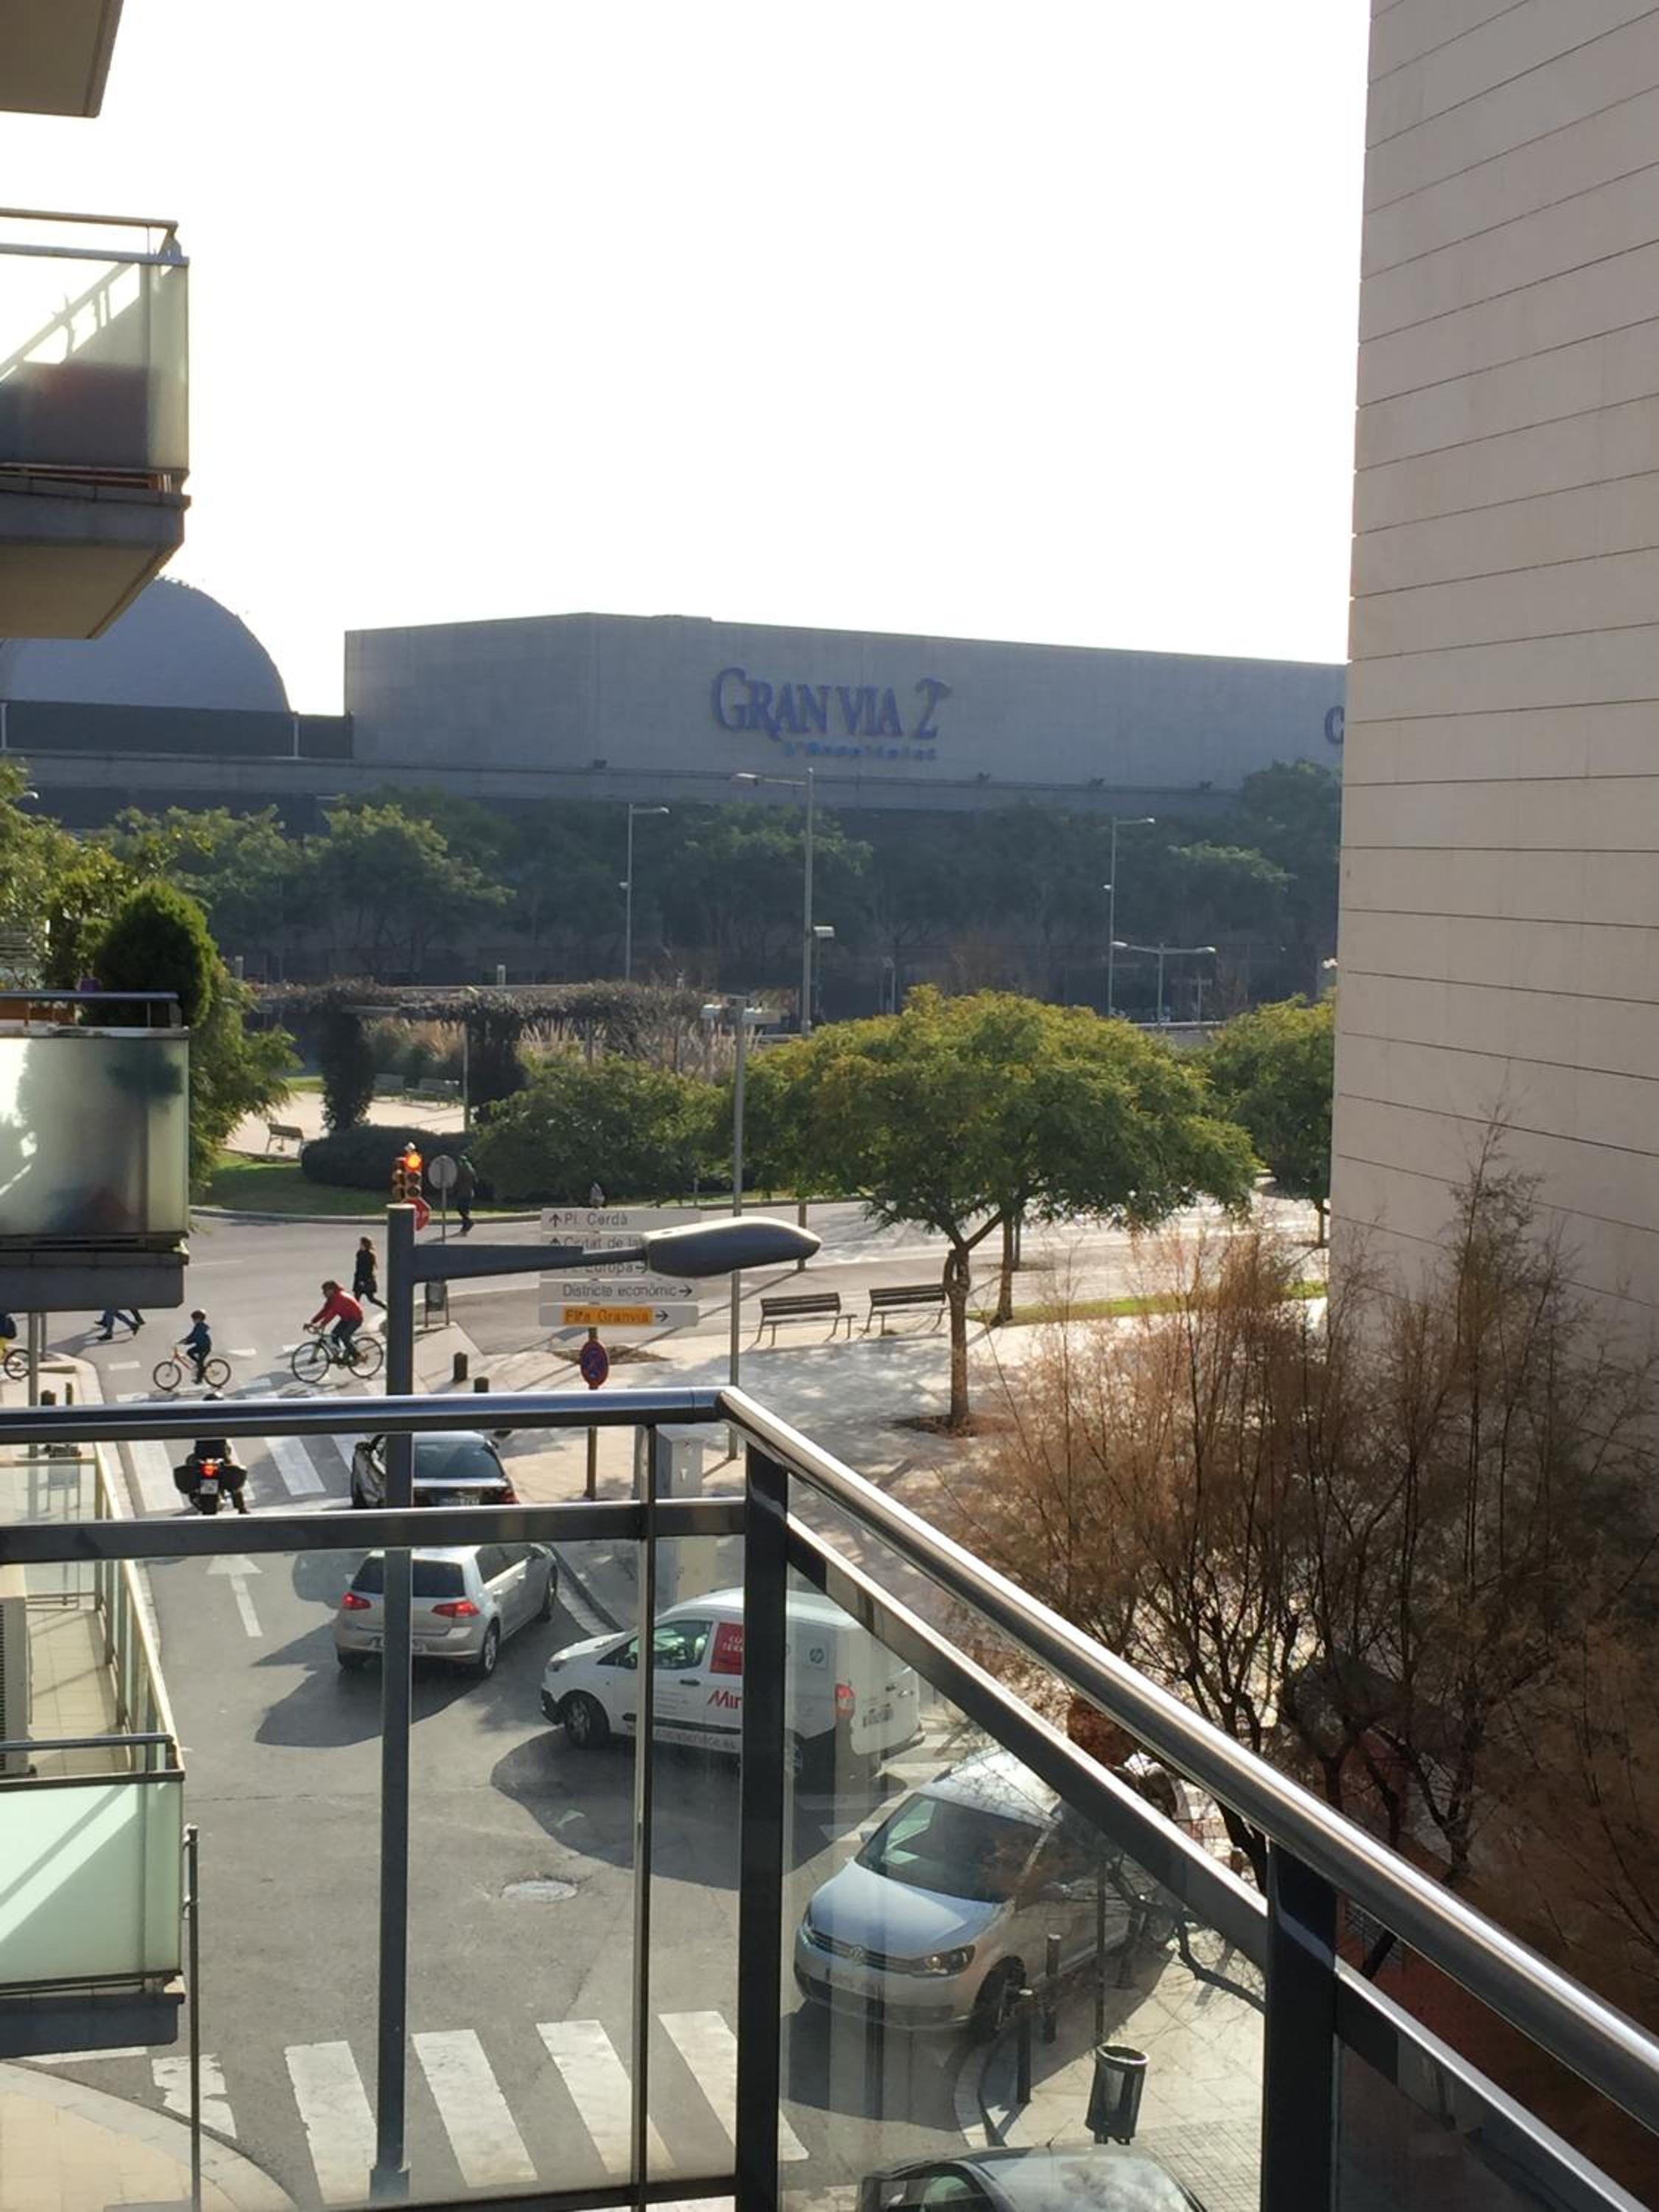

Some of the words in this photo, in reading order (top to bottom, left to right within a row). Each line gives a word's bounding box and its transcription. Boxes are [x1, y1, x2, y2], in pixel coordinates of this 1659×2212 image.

[712, 667, 830, 742] GRAN
[835, 684, 903, 737] VIA
[915, 677, 952, 739] 2
[588, 1211, 627, 1225] Cerdà
[608, 1235, 623, 1248] de
[563, 1284, 613, 1297] Districte
